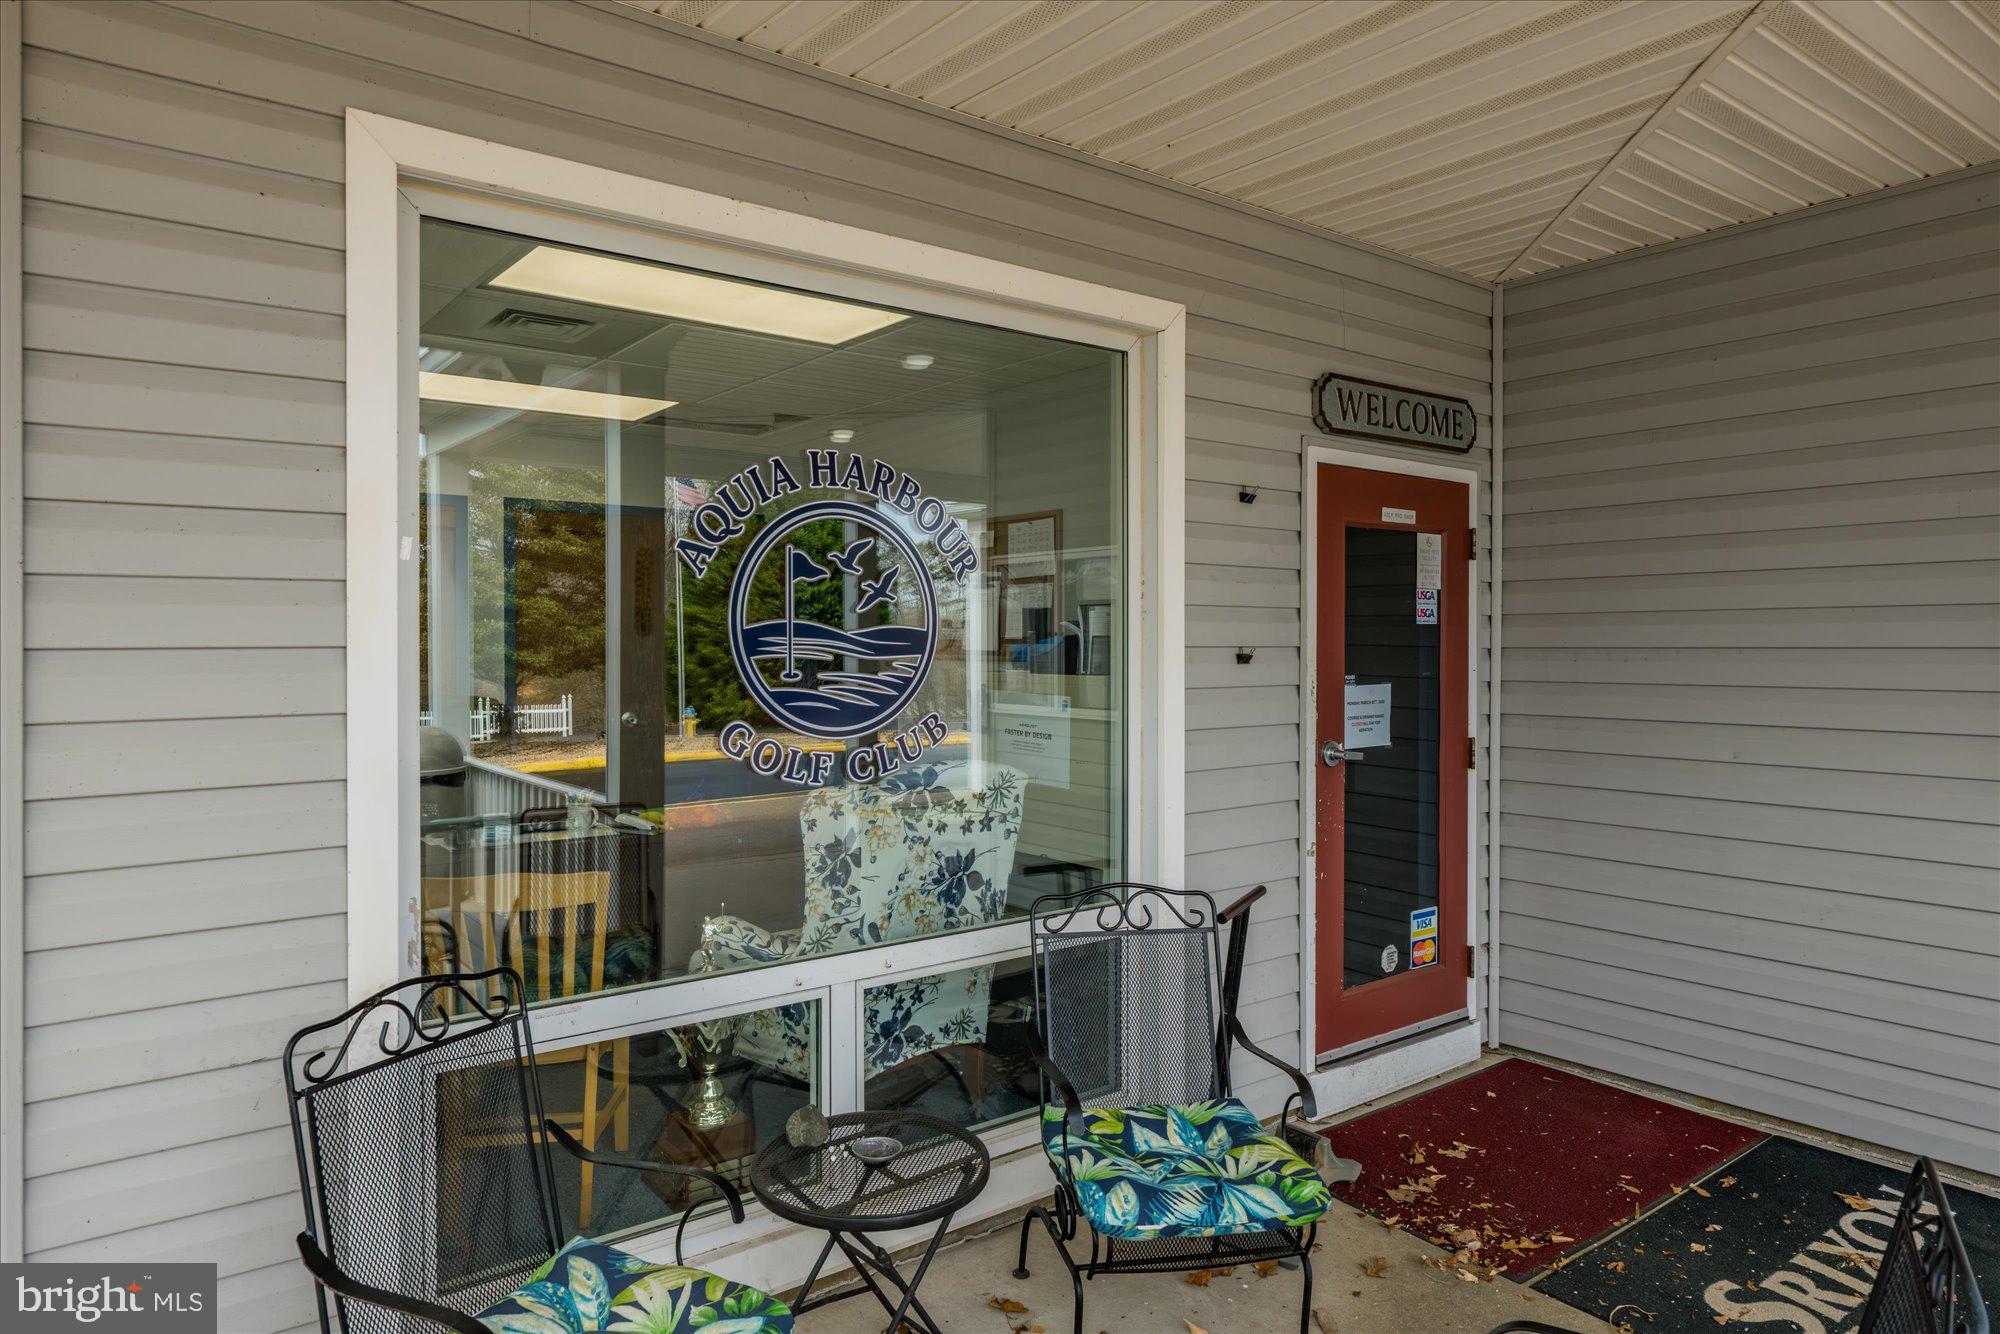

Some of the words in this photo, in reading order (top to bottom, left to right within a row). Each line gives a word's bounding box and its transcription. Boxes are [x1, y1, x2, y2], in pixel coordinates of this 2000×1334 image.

[1335, 386, 1464, 441] WELCOME
[675, 456, 801, 578] AQUIA
[807, 449, 979, 585] HARBOUR
[1417, 590, 1435, 600] USGA
[1417, 608, 1435, 617] USGA
[1004, 728, 1024, 737] FASTER
[1024, 730, 1031, 738] BY
[1032, 731, 1053, 741] DESIGN
[719, 720, 834, 786] GOLF
[847, 712, 949, 784] CLUB
[1416, 918, 1432, 930] VISA
